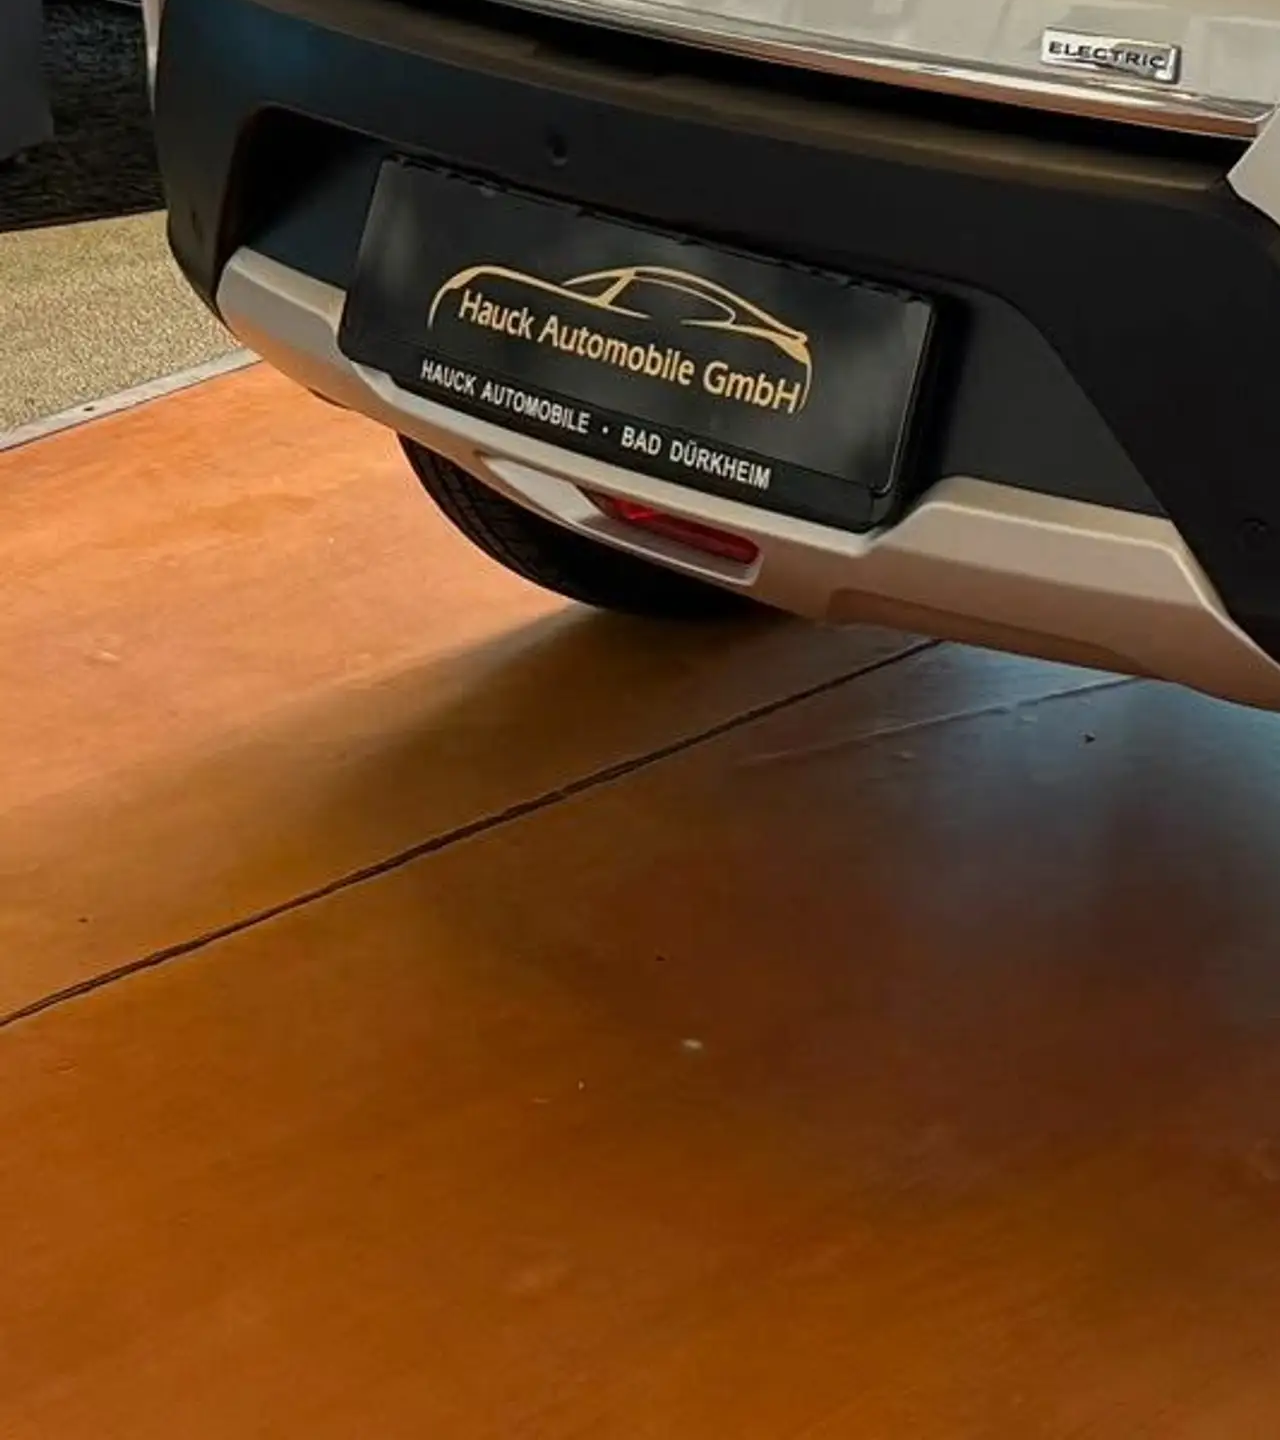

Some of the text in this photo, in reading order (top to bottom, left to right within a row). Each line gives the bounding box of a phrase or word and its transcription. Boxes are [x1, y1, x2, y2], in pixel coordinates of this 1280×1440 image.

[1048, 41, 1168, 70] ELECTRIC
[458, 288, 803, 414] Hauck Automobile GmbH
[421, 358, 772, 491] HAUCK AUTOMOBILE BAD DÜRKHEIM
